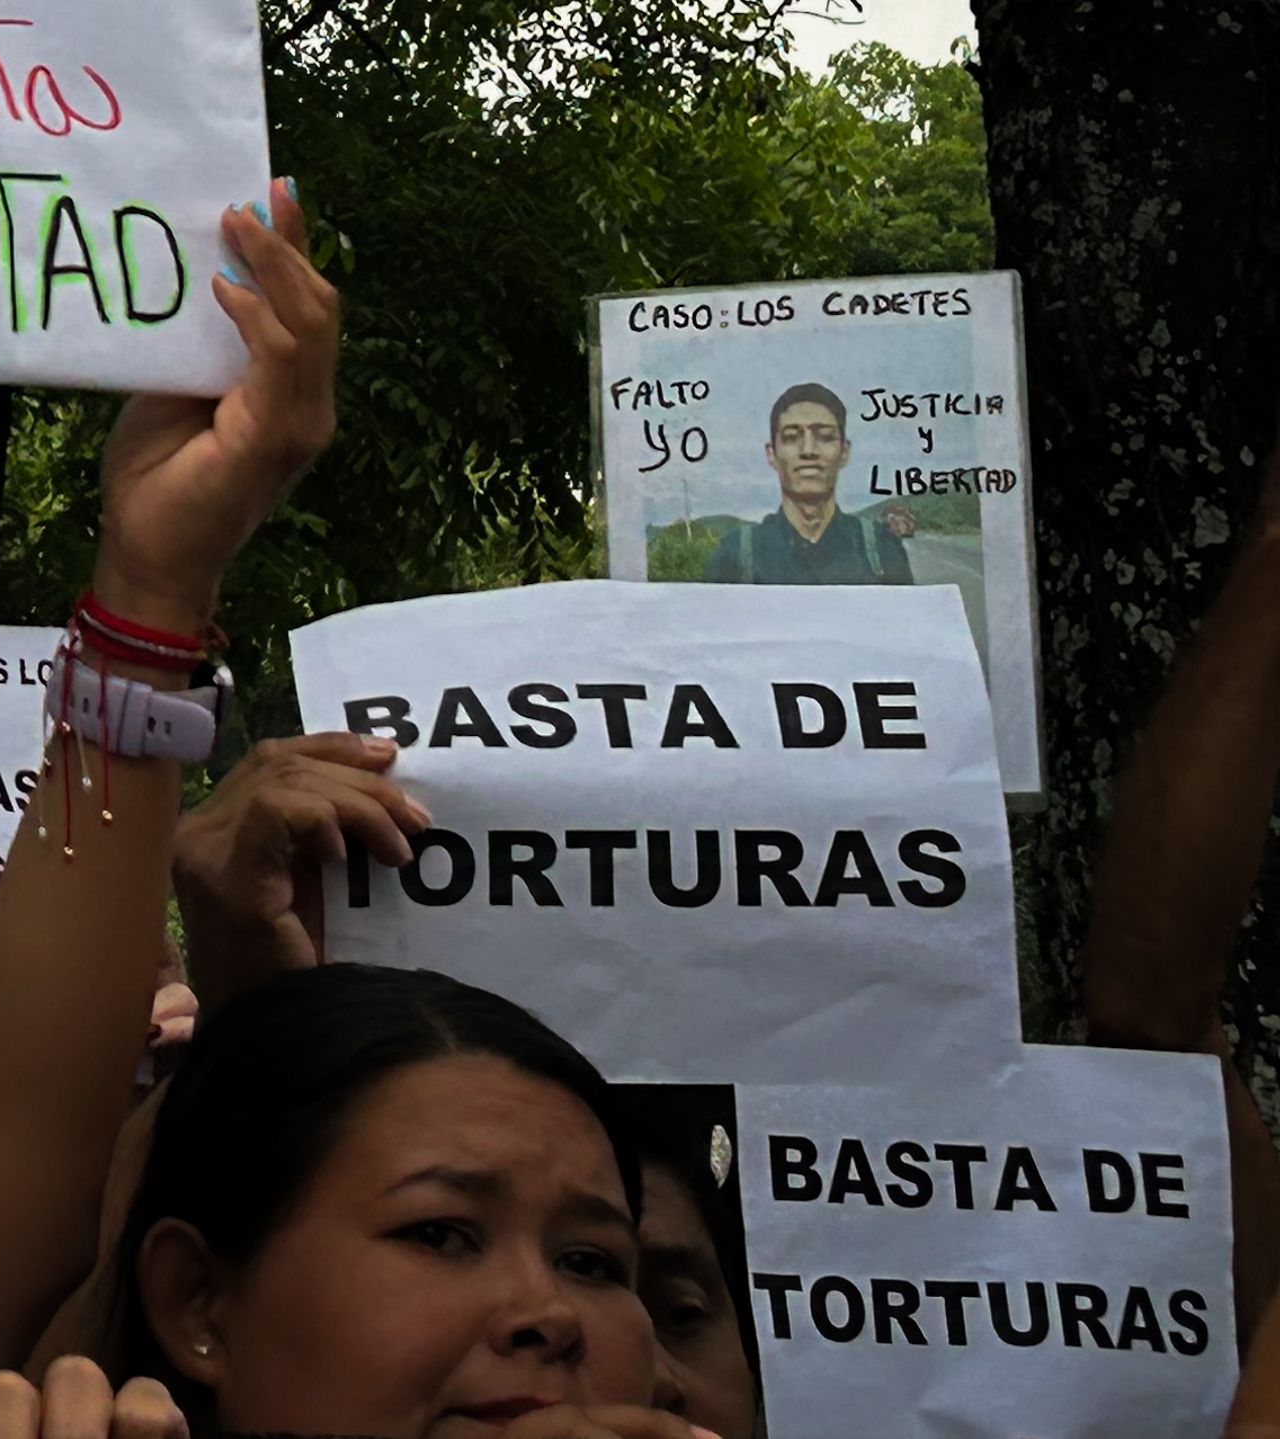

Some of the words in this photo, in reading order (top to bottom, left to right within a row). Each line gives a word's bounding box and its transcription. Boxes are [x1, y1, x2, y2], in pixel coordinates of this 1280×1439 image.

[737, 295, 796, 327] LOS
[822, 288, 973, 318] CADETES
[610, 377, 710, 412] FALTO
[869, 465, 1017, 497] LIBERTAD
[343, 682, 741, 750] BASTA
[771, 681, 929, 750] DE
[767, 1134, 1059, 1213] BASTA
[1083, 1148, 1191, 1220] DE
[752, 1272, 1210, 1358] TORTURAS
